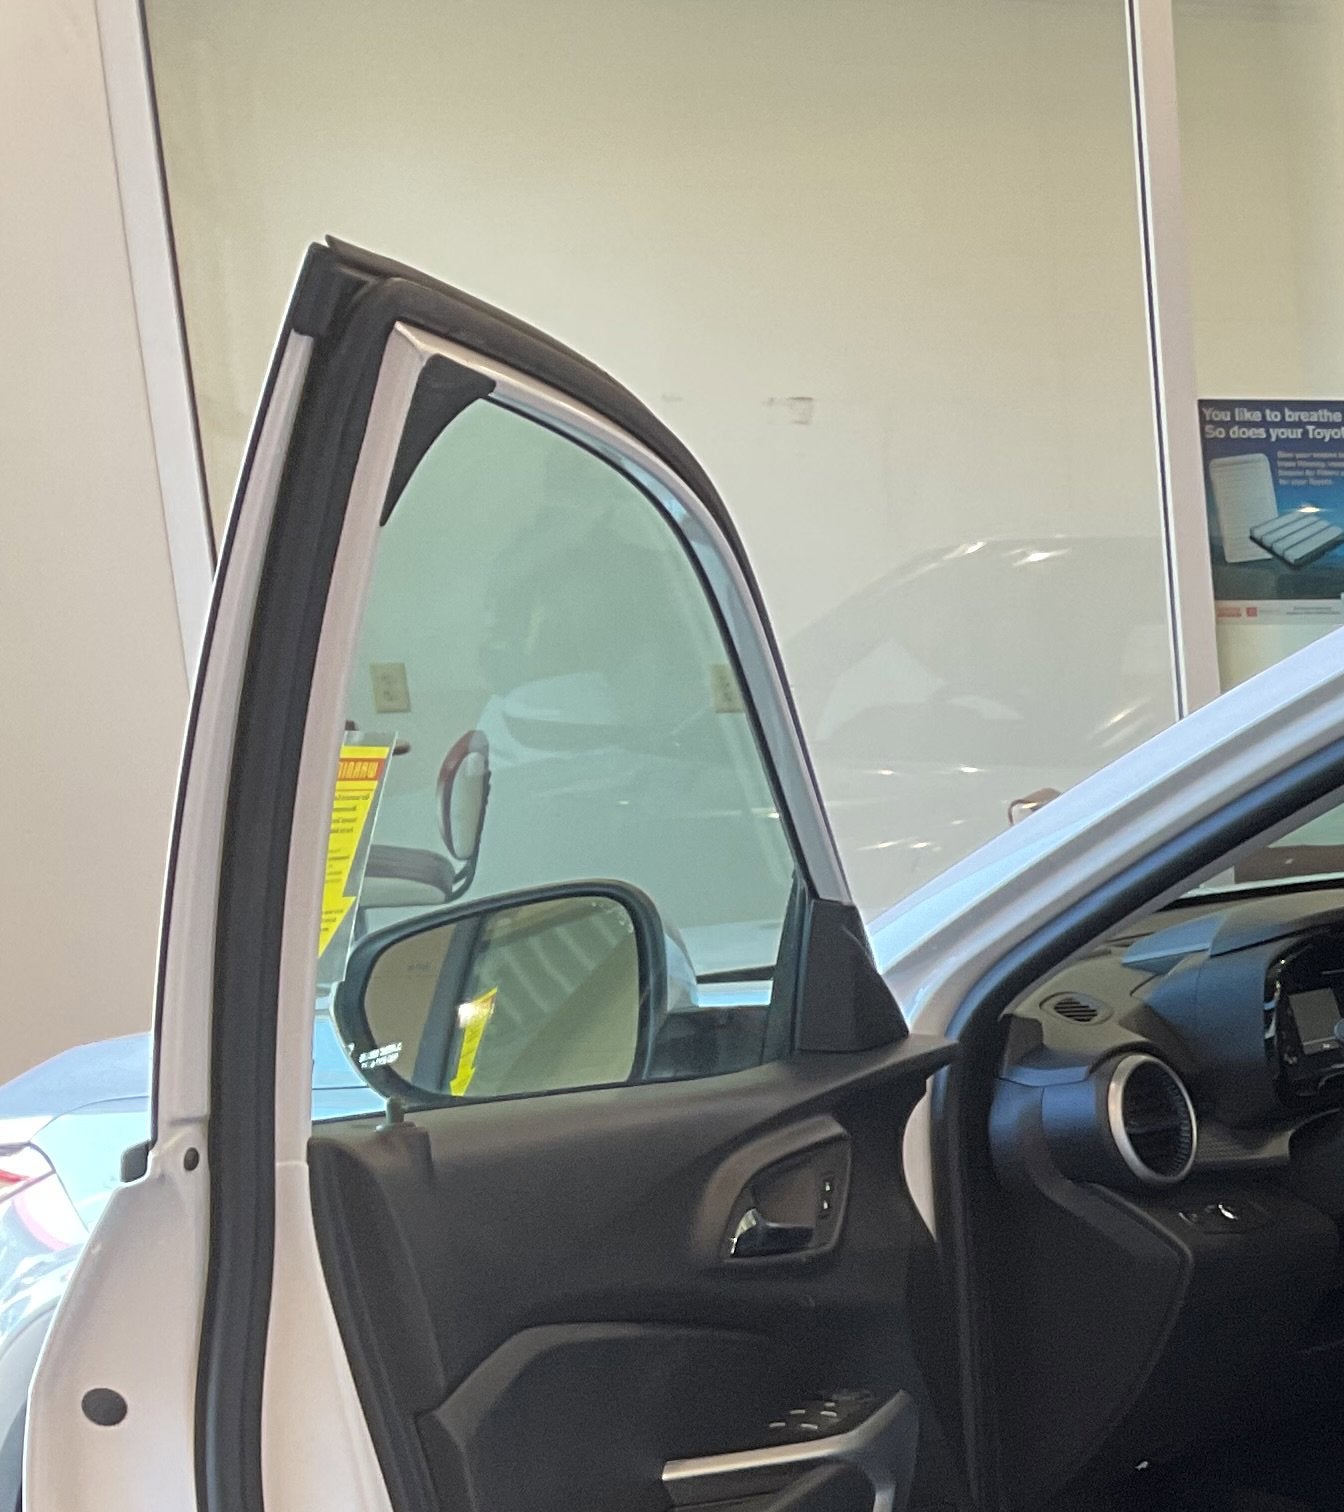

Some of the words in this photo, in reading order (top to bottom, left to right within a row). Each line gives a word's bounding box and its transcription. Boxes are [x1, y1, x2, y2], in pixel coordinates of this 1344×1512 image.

[1202, 407, 1231, 422] You
[1234, 407, 1262, 422] like
[1265, 408, 1281, 422] to
[1284, 408, 1342, 422] breathe
[1204, 425, 1226, 439] So
[1229, 425, 1267, 439] does
[1269, 428, 1303, 442] your
